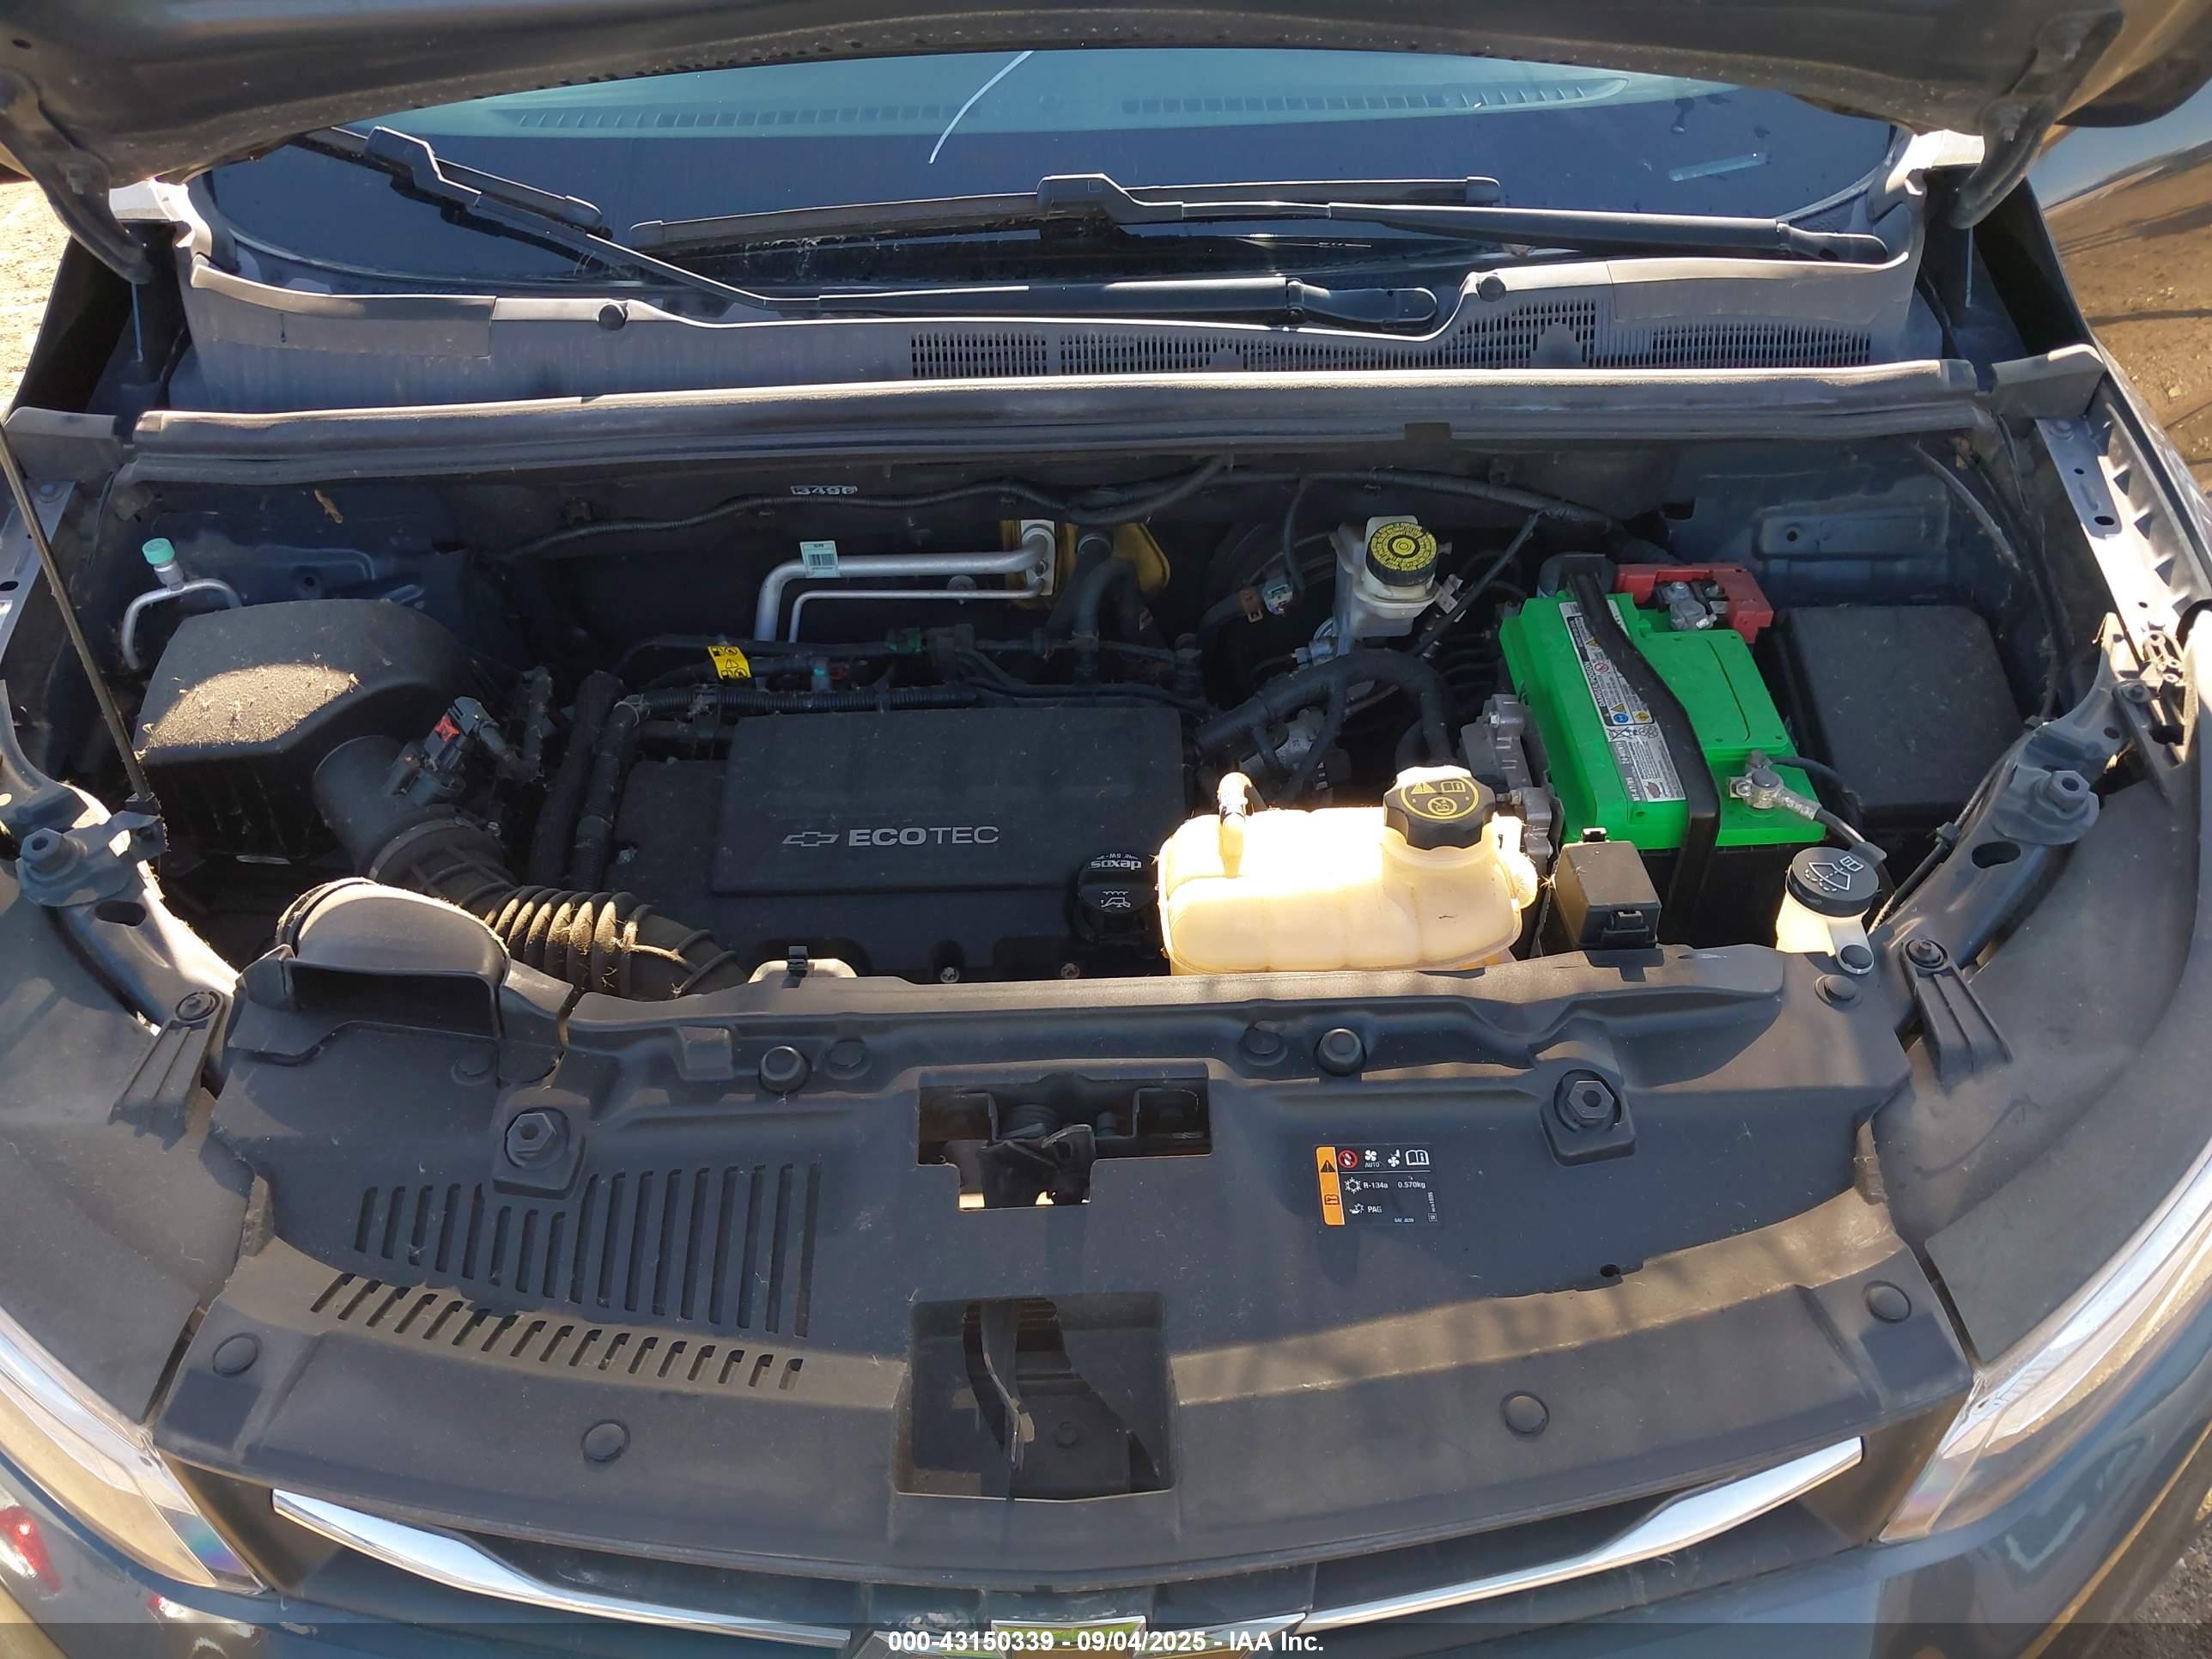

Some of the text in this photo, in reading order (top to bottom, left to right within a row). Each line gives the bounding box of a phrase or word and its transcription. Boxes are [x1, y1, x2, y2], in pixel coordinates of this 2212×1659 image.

[848, 826, 1000, 847] ECOTEC
[1091, 860, 1142, 871] dexos
[1397, 1181, 1426, 1189] 0.570kg
